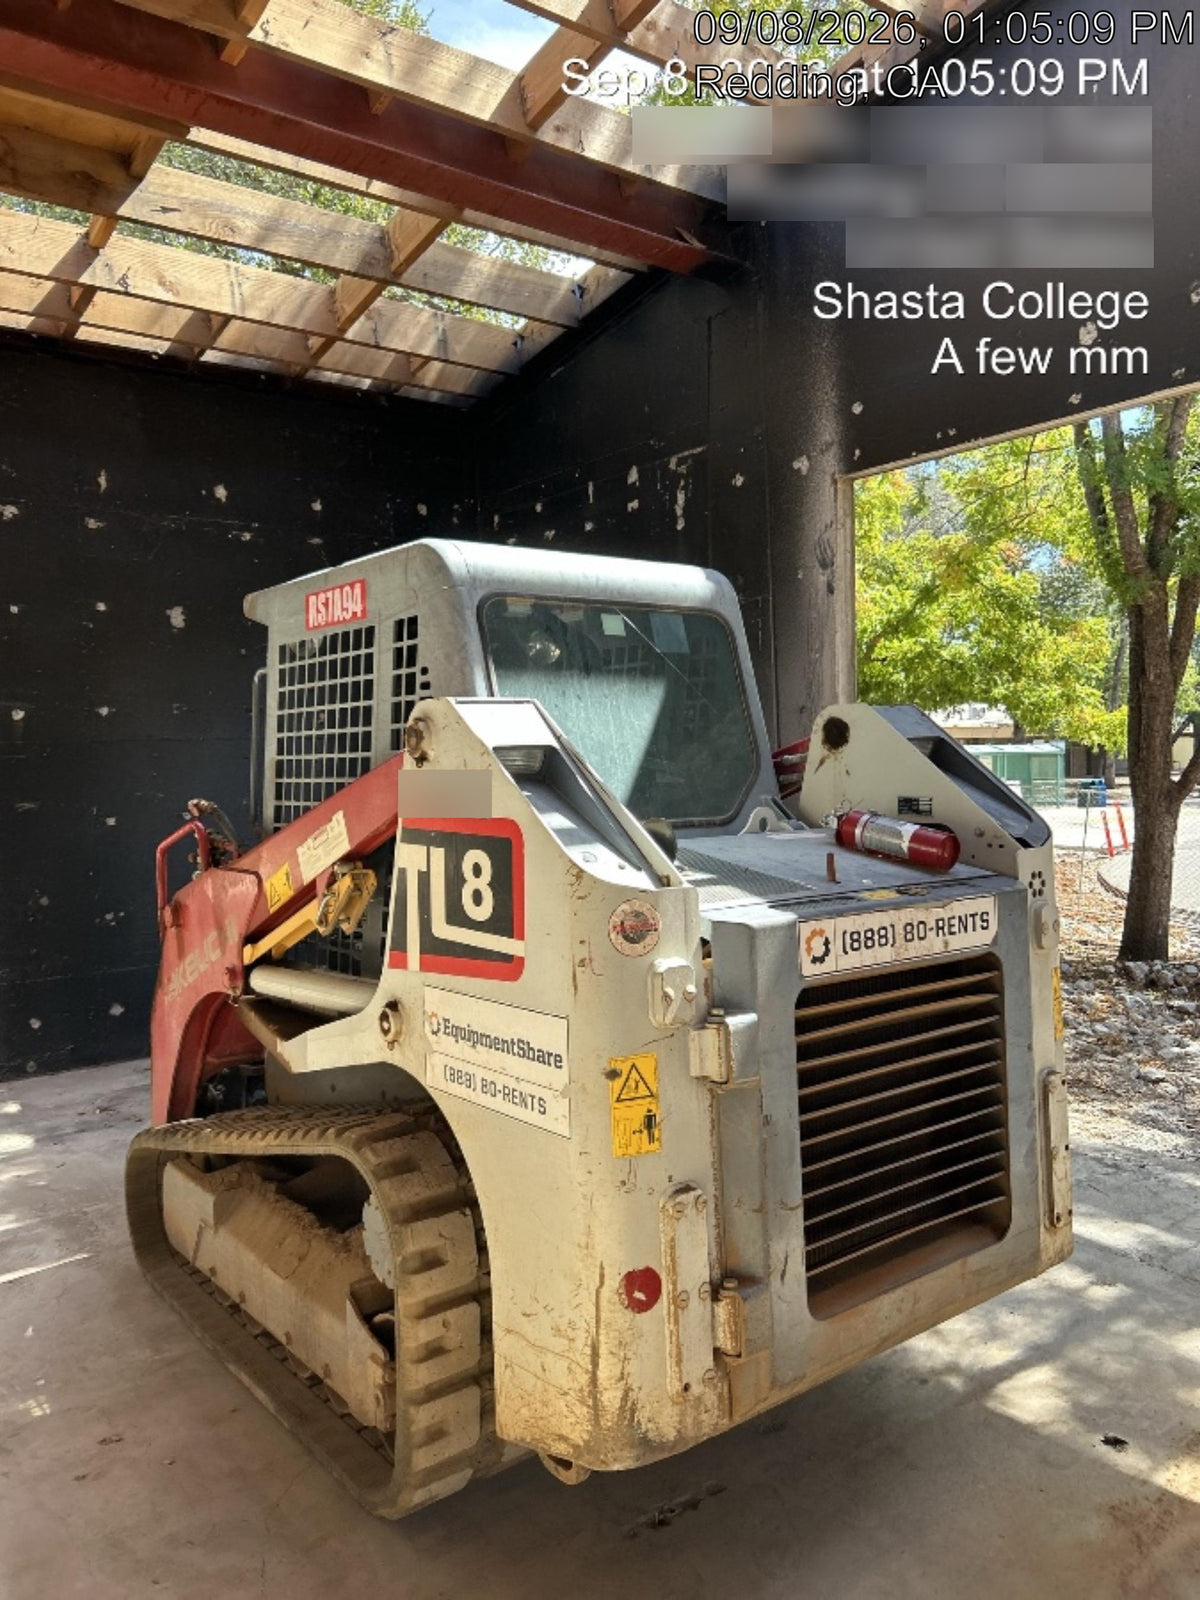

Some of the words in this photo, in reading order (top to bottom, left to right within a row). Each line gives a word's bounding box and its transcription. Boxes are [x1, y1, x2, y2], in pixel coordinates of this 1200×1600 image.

[397, 842, 525, 971] TL8
[842, 925, 896, 955] (888)
[904, 911, 990, 943] 80-RENTS
[442, 1017, 563, 1070] EquipmentShare
[444, 1064, 477, 1093] (888)
[481, 1077, 548, 1116] 80-RENTS
